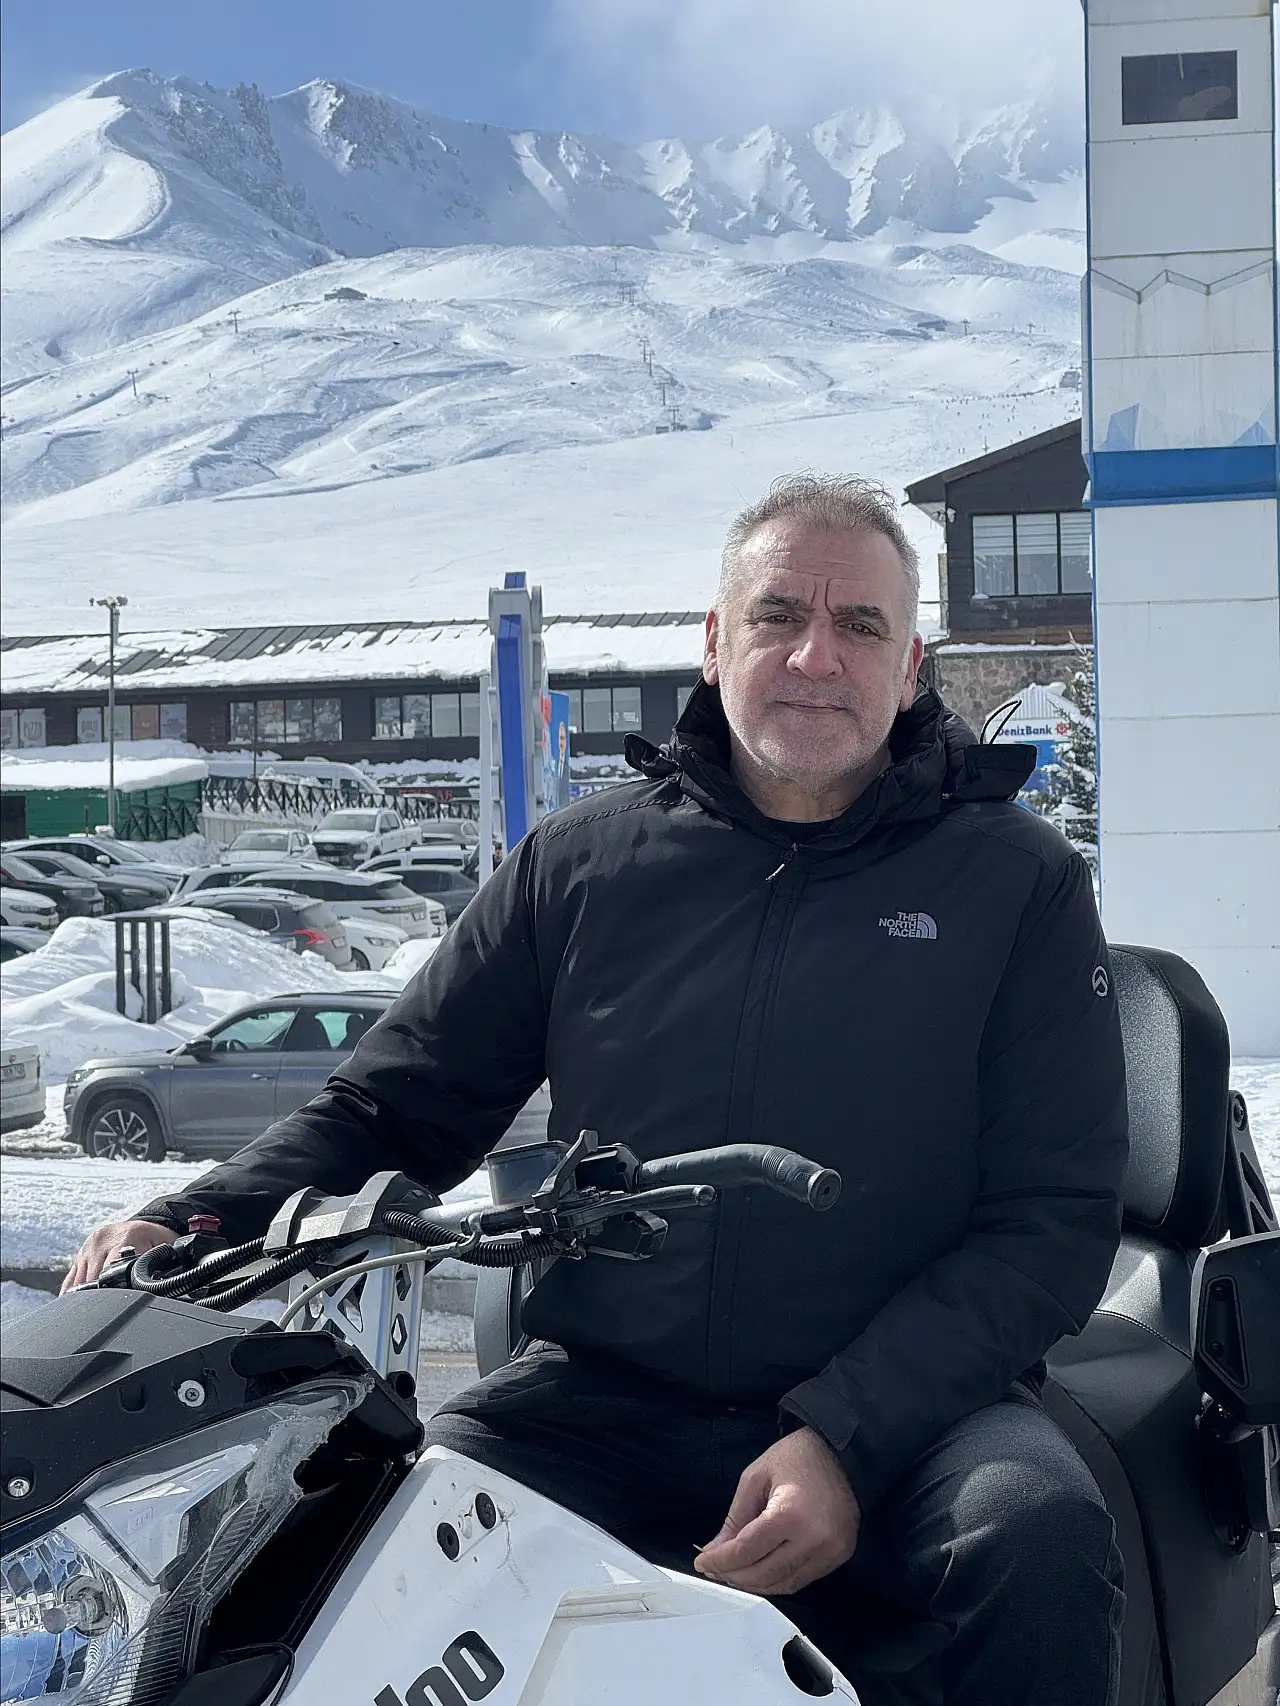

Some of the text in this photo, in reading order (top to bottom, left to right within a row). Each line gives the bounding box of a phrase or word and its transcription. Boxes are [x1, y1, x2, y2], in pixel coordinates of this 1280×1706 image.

[897, 911, 917, 921] THE
[879, 918, 917, 929] NORTH
[888, 928, 916, 938] FACE
[373, 1630, 505, 1706] oo
